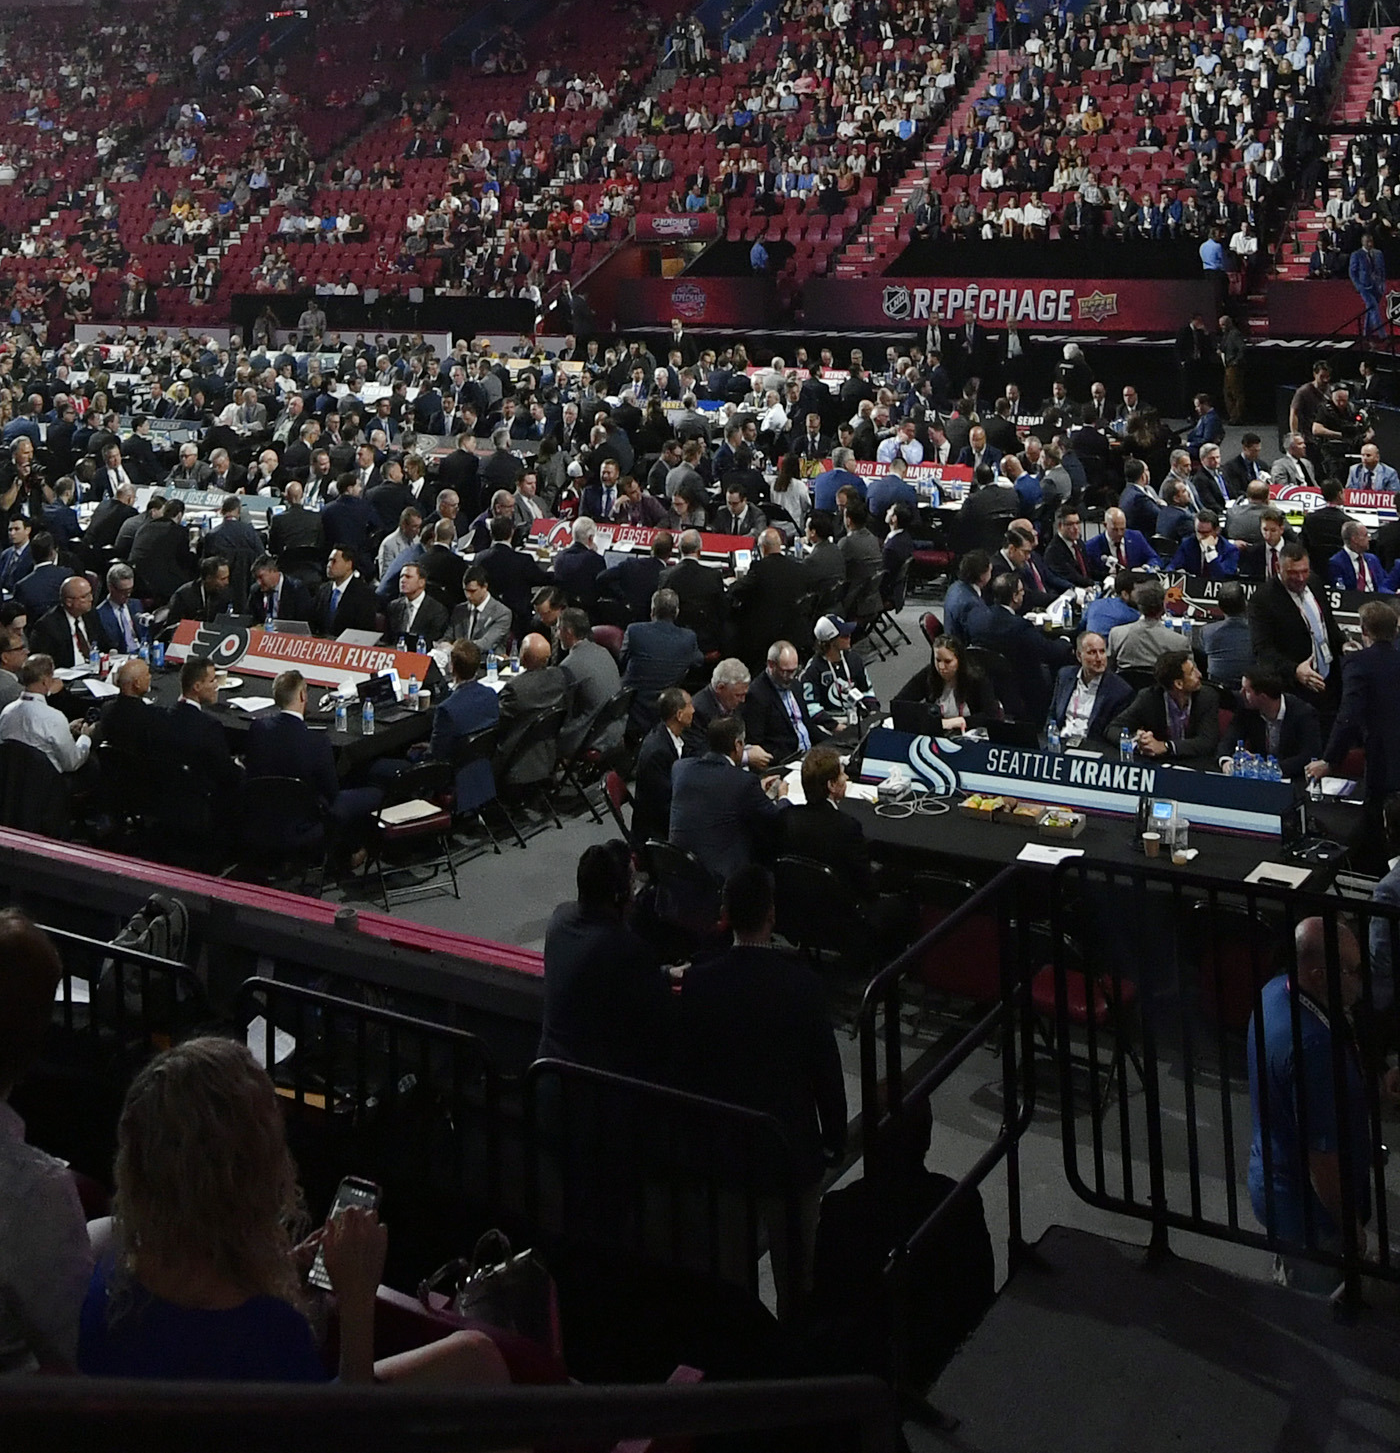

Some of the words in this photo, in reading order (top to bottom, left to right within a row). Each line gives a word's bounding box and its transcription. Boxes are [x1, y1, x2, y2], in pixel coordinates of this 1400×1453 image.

[914, 284, 1074, 322] REPÊCHAGE
[615, 526, 654, 545] JERSEY
[257, 633, 341, 665] PHILADELPHIA
[343, 645, 396, 671] FLYERS
[986, 747, 1063, 782] SEATTLE
[1068, 757, 1156, 794] KRAKEN
